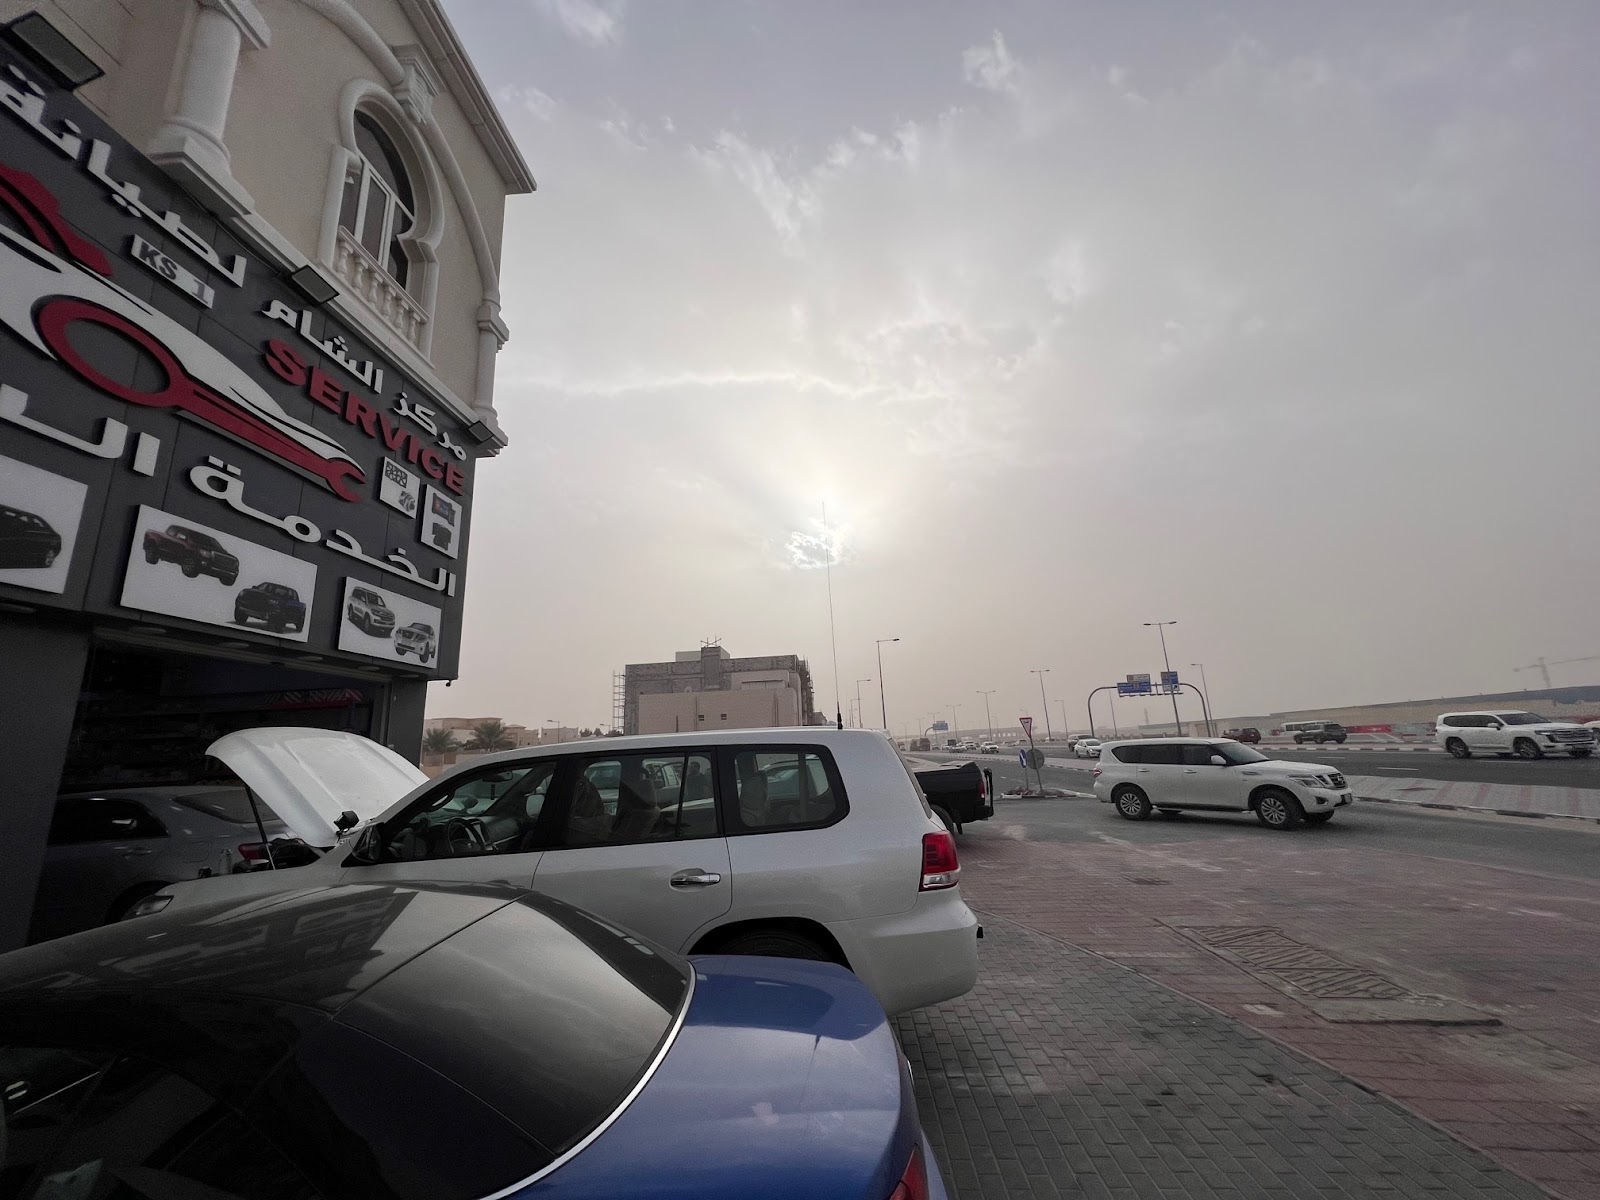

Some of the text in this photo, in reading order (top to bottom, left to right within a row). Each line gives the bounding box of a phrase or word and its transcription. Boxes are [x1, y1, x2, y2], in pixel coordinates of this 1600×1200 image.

[139, 241, 178, 280] KS
[261, 300, 384, 394] الشام
[265, 338, 465, 495] SERVICE
[393, 392, 467, 461] مركز
[189, 455, 456, 597] الخدمة
